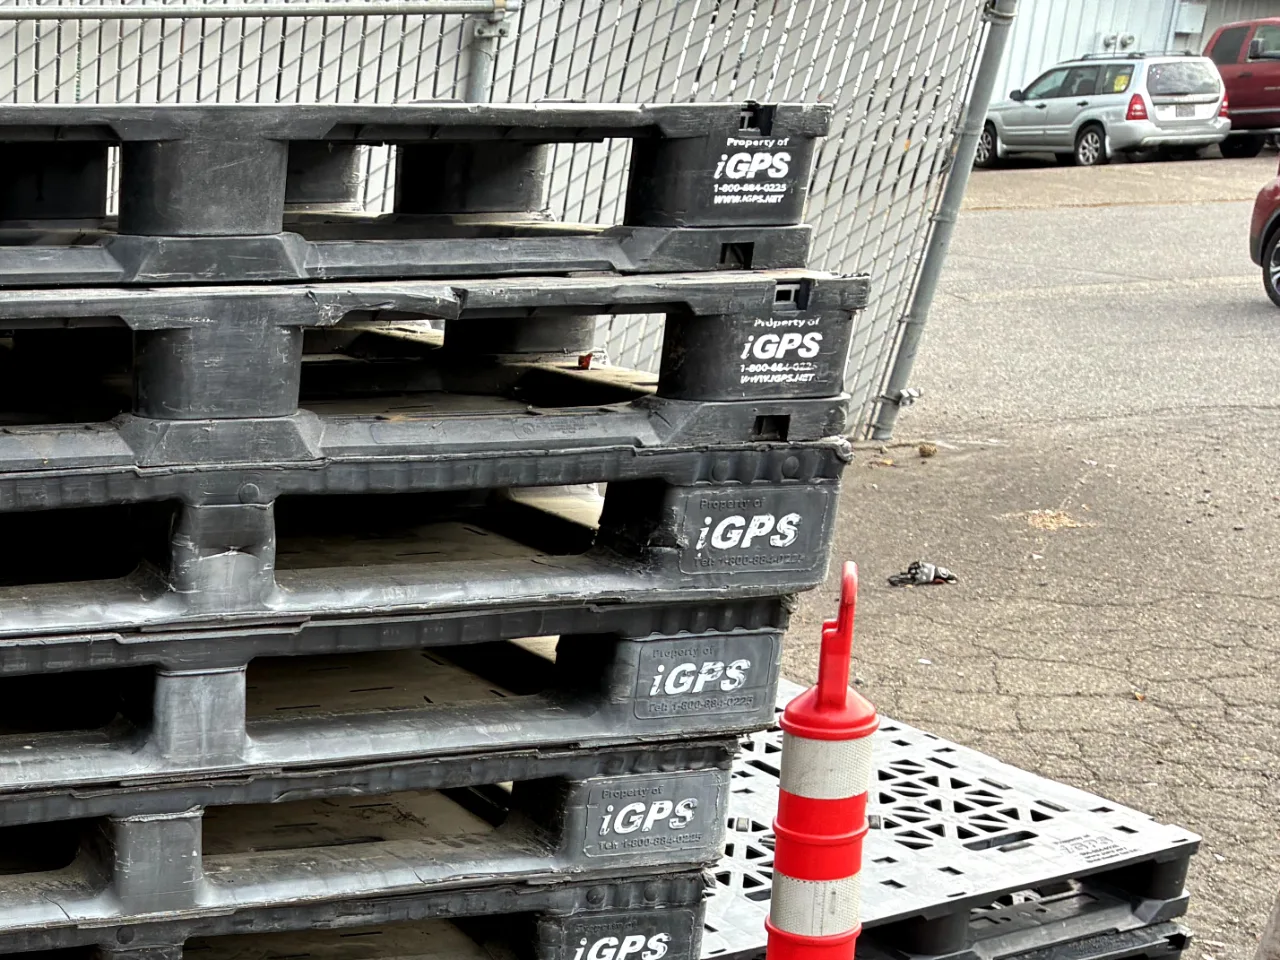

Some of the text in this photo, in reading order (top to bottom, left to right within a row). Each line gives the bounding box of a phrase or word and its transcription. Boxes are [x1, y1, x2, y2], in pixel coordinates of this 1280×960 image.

[727, 137, 790, 148] Property of
[713, 152, 792, 180] iGPS
[713, 194, 785, 205] WWW.IGPS.NET
[753, 317, 820, 329] Property of
[740, 331, 823, 360] iGPS
[699, 497, 766, 510] Property of
[695, 513, 802, 550] iGPS
[652, 645, 713, 658] Property of
[649, 658, 751, 697] iGPS
[601, 785, 664, 799] Property of
[598, 798, 698, 836] iGPS
